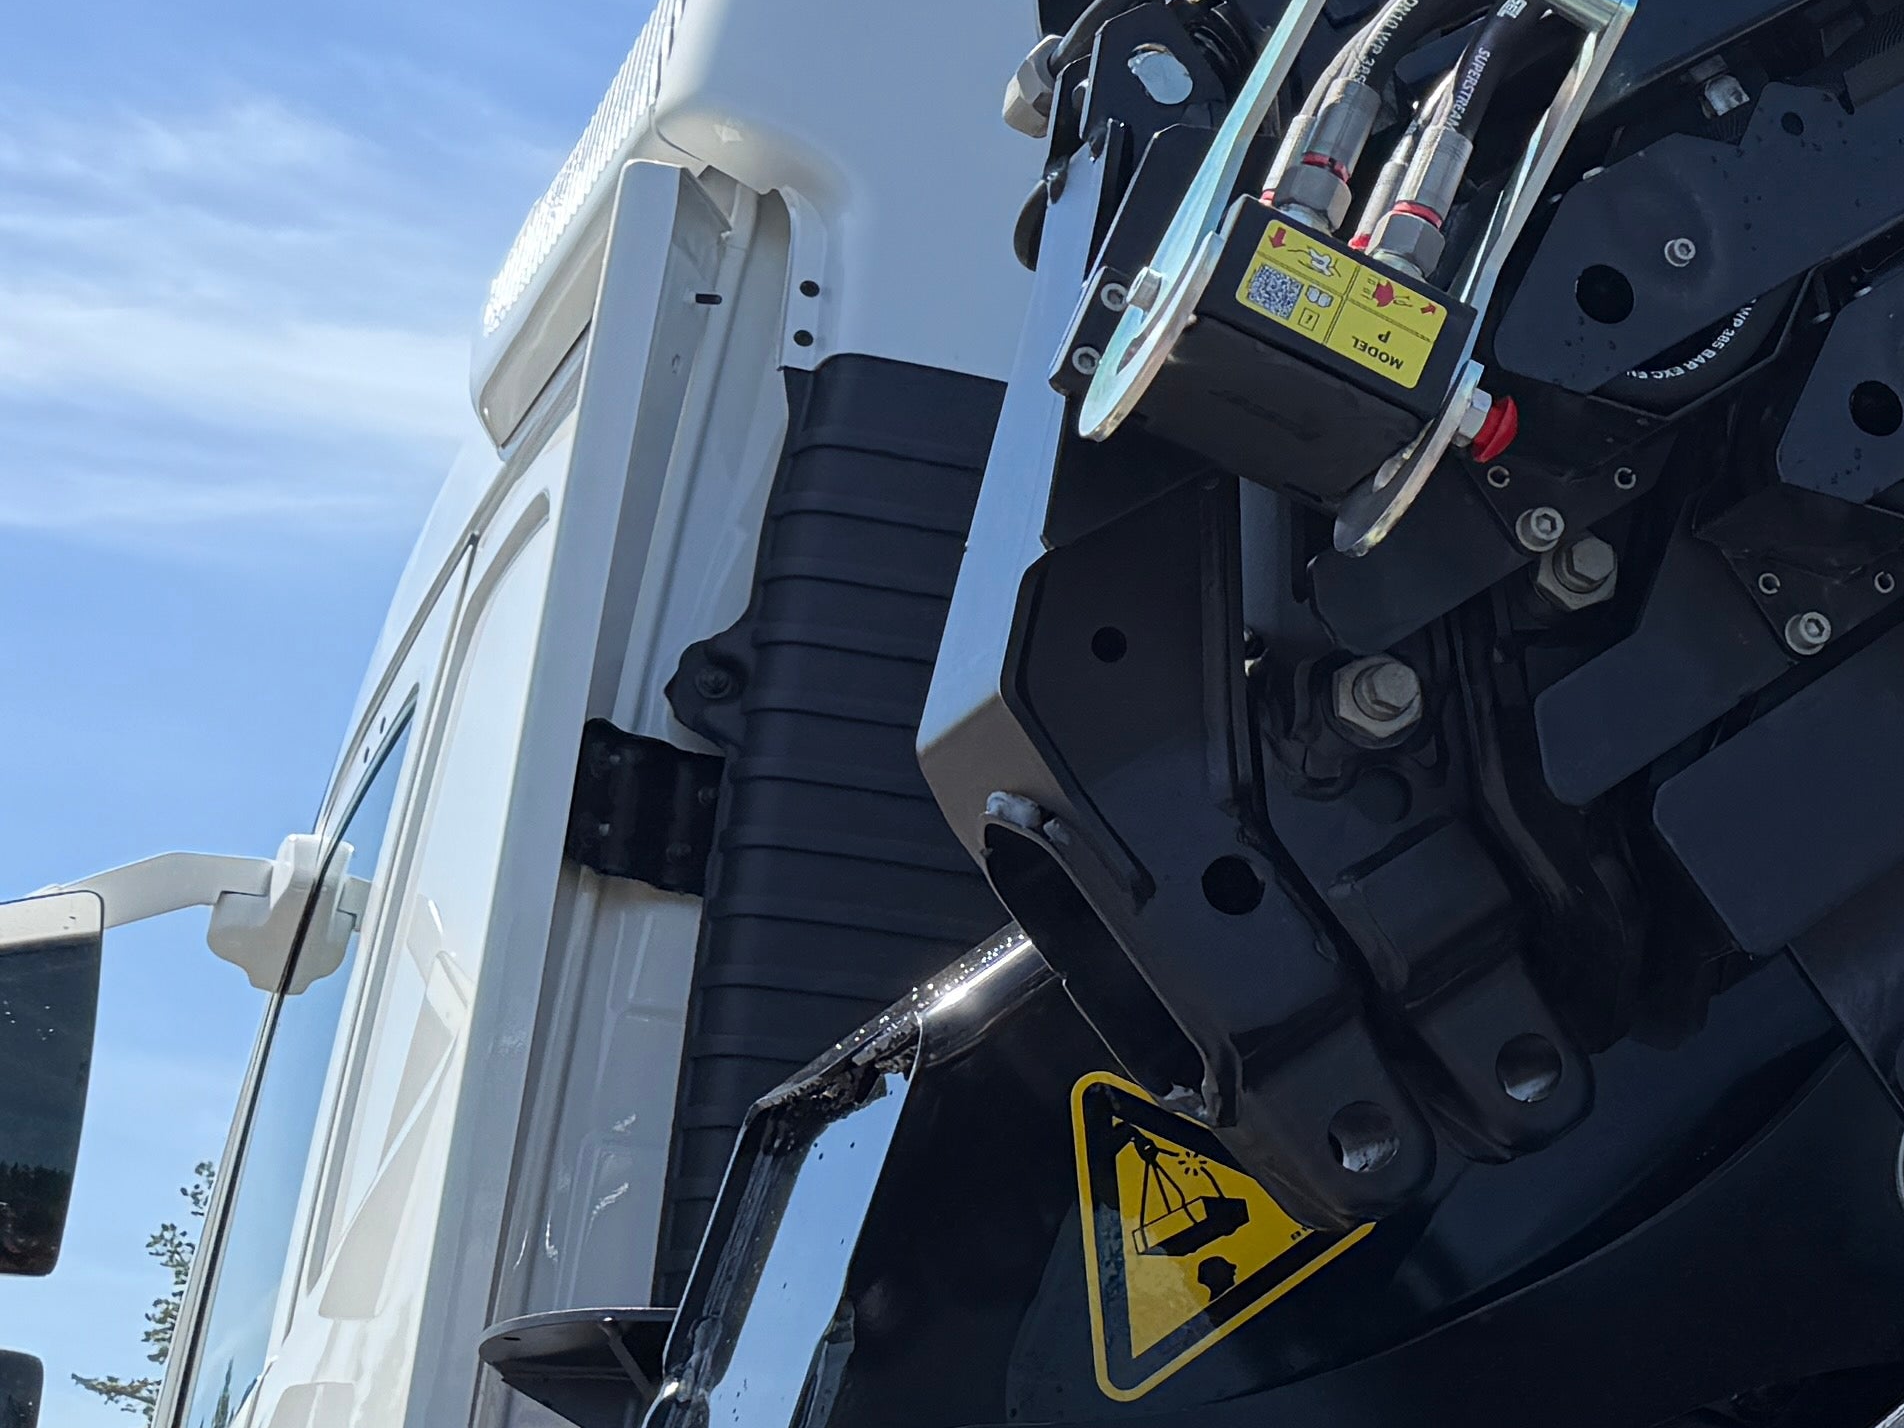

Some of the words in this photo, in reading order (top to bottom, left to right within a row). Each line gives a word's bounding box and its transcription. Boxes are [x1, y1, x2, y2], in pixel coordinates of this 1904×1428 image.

[1441, 46, 1491, 131] SUPERSTREAM
[1377, 330, 1392, 344] P
[1351, 335, 1404, 370] MODEL
[1682, 347, 1717, 372] BAR
